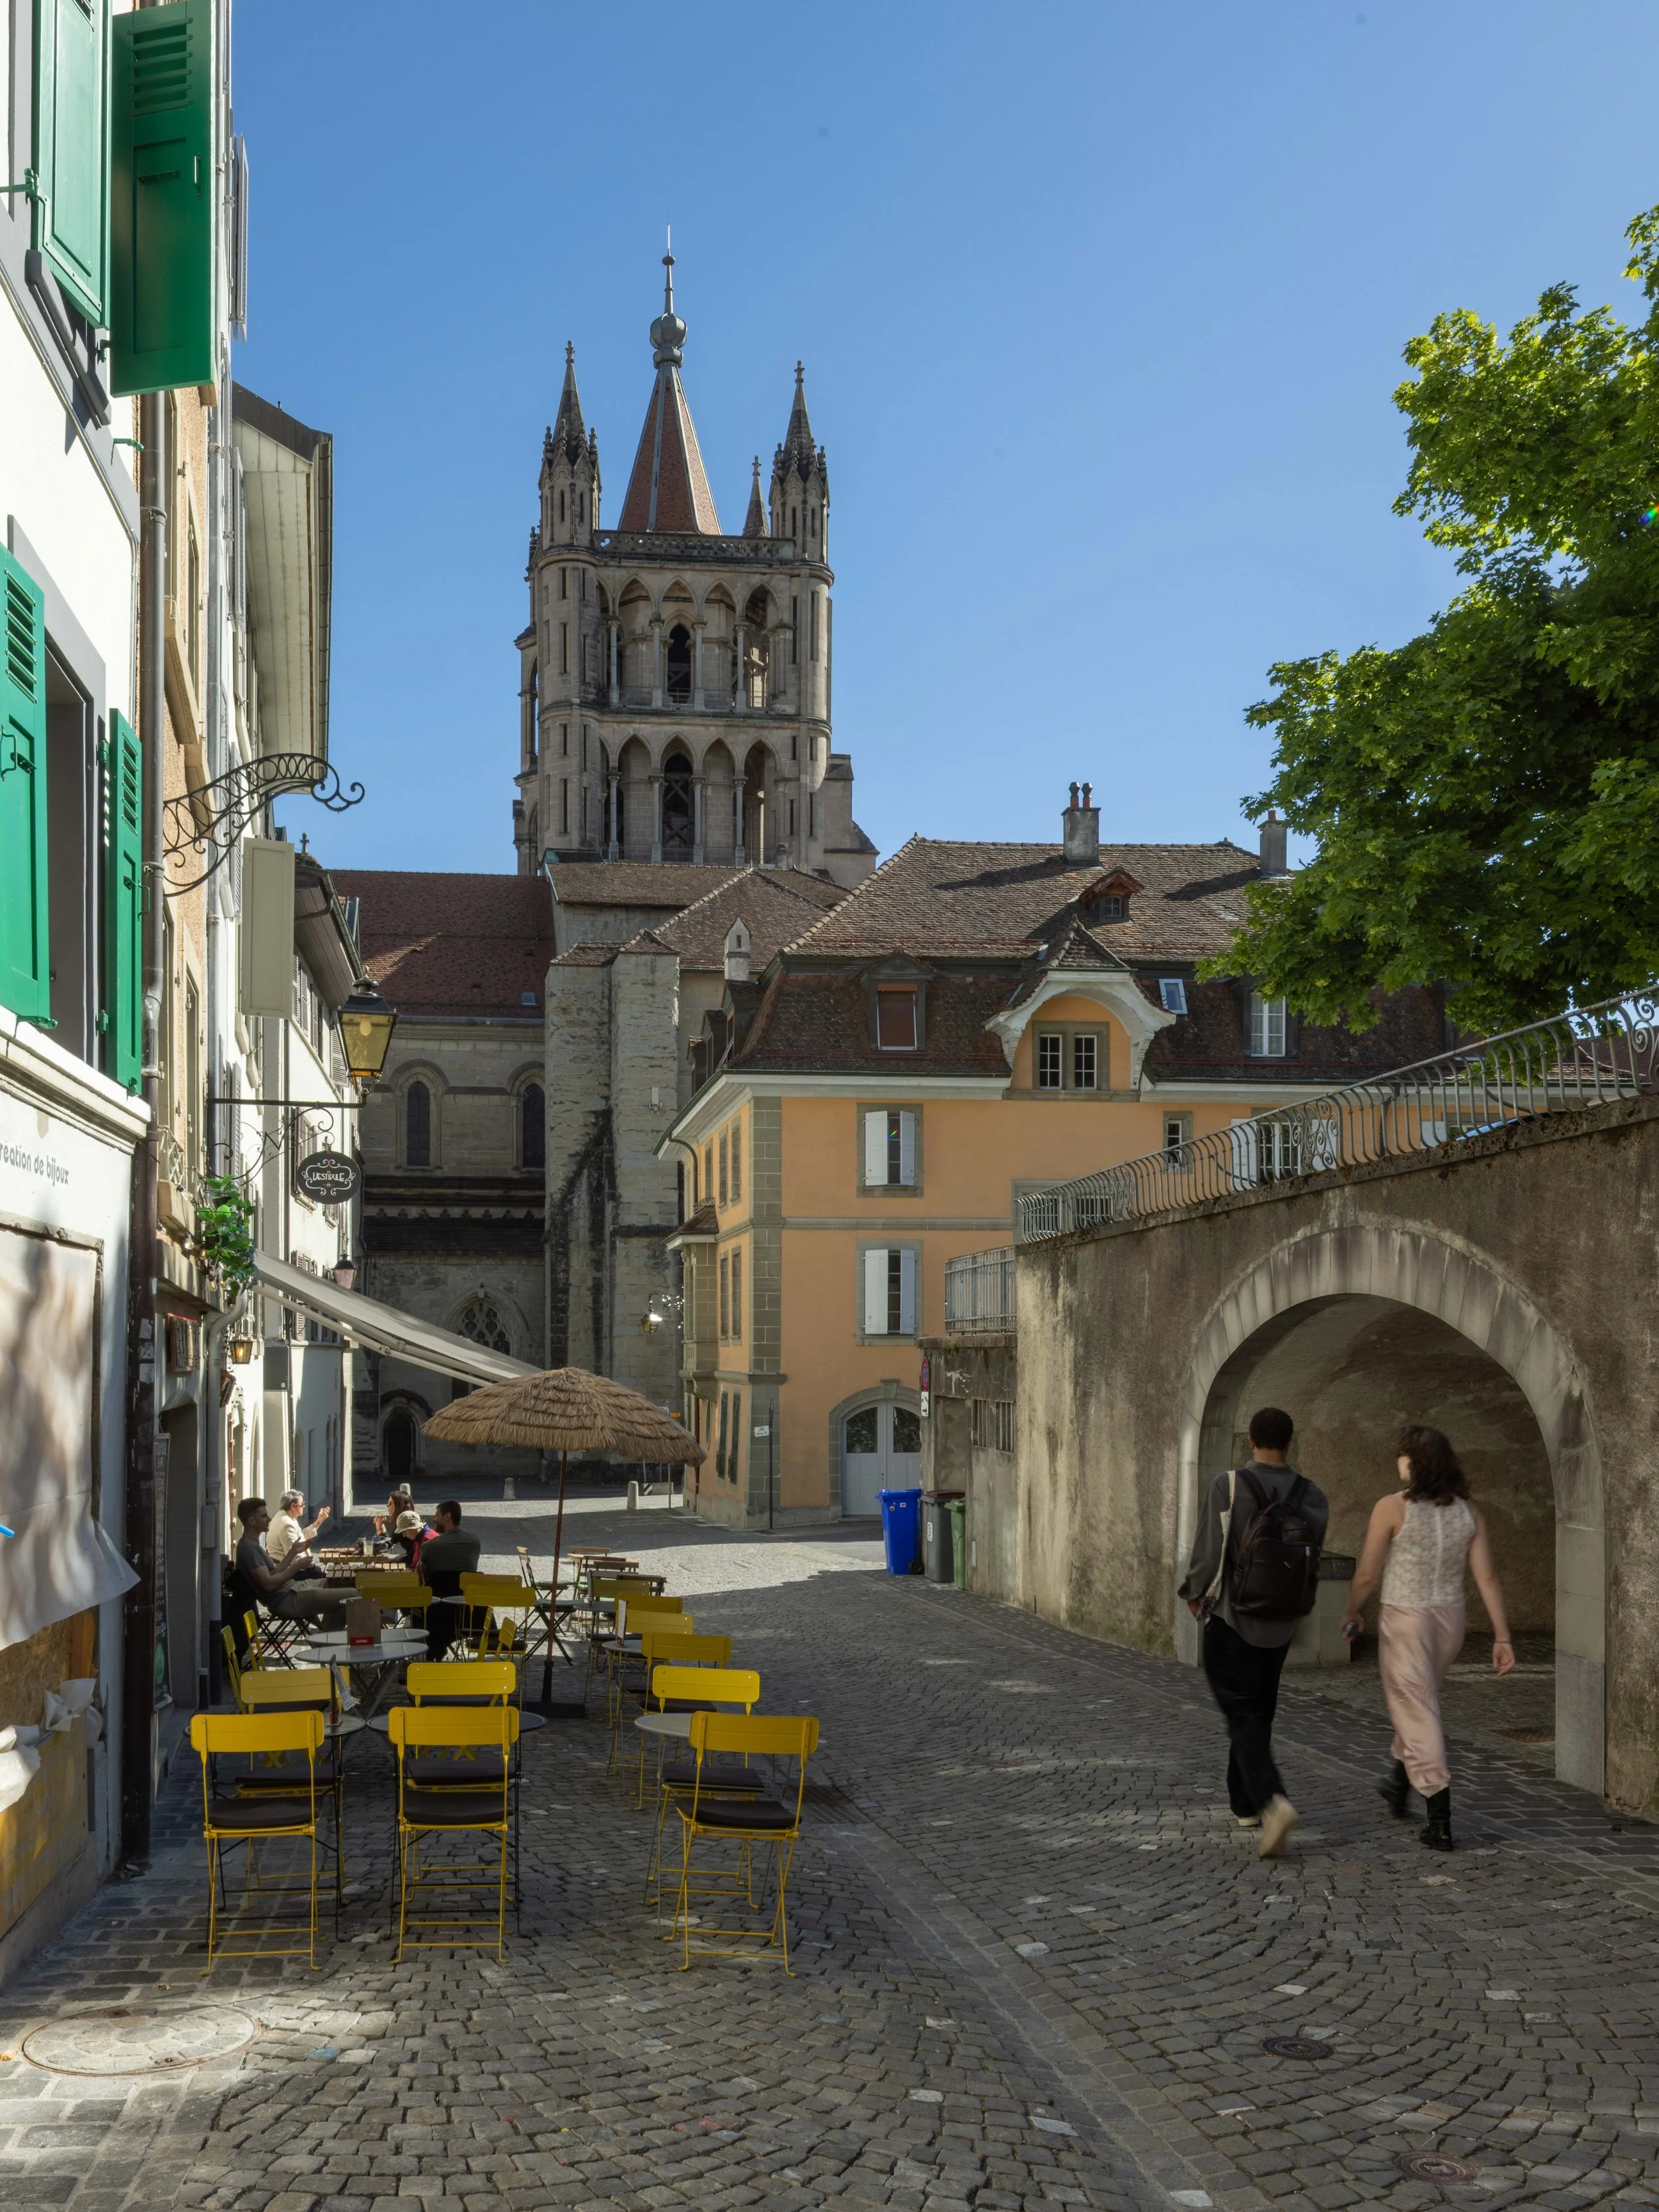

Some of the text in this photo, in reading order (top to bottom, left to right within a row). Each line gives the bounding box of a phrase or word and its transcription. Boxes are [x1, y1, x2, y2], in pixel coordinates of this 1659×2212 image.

[34, 1155, 44, 1176] de
[46, 1155, 69, 1187] bijoux
[313, 1172, 345, 1182] VESTIBULE
